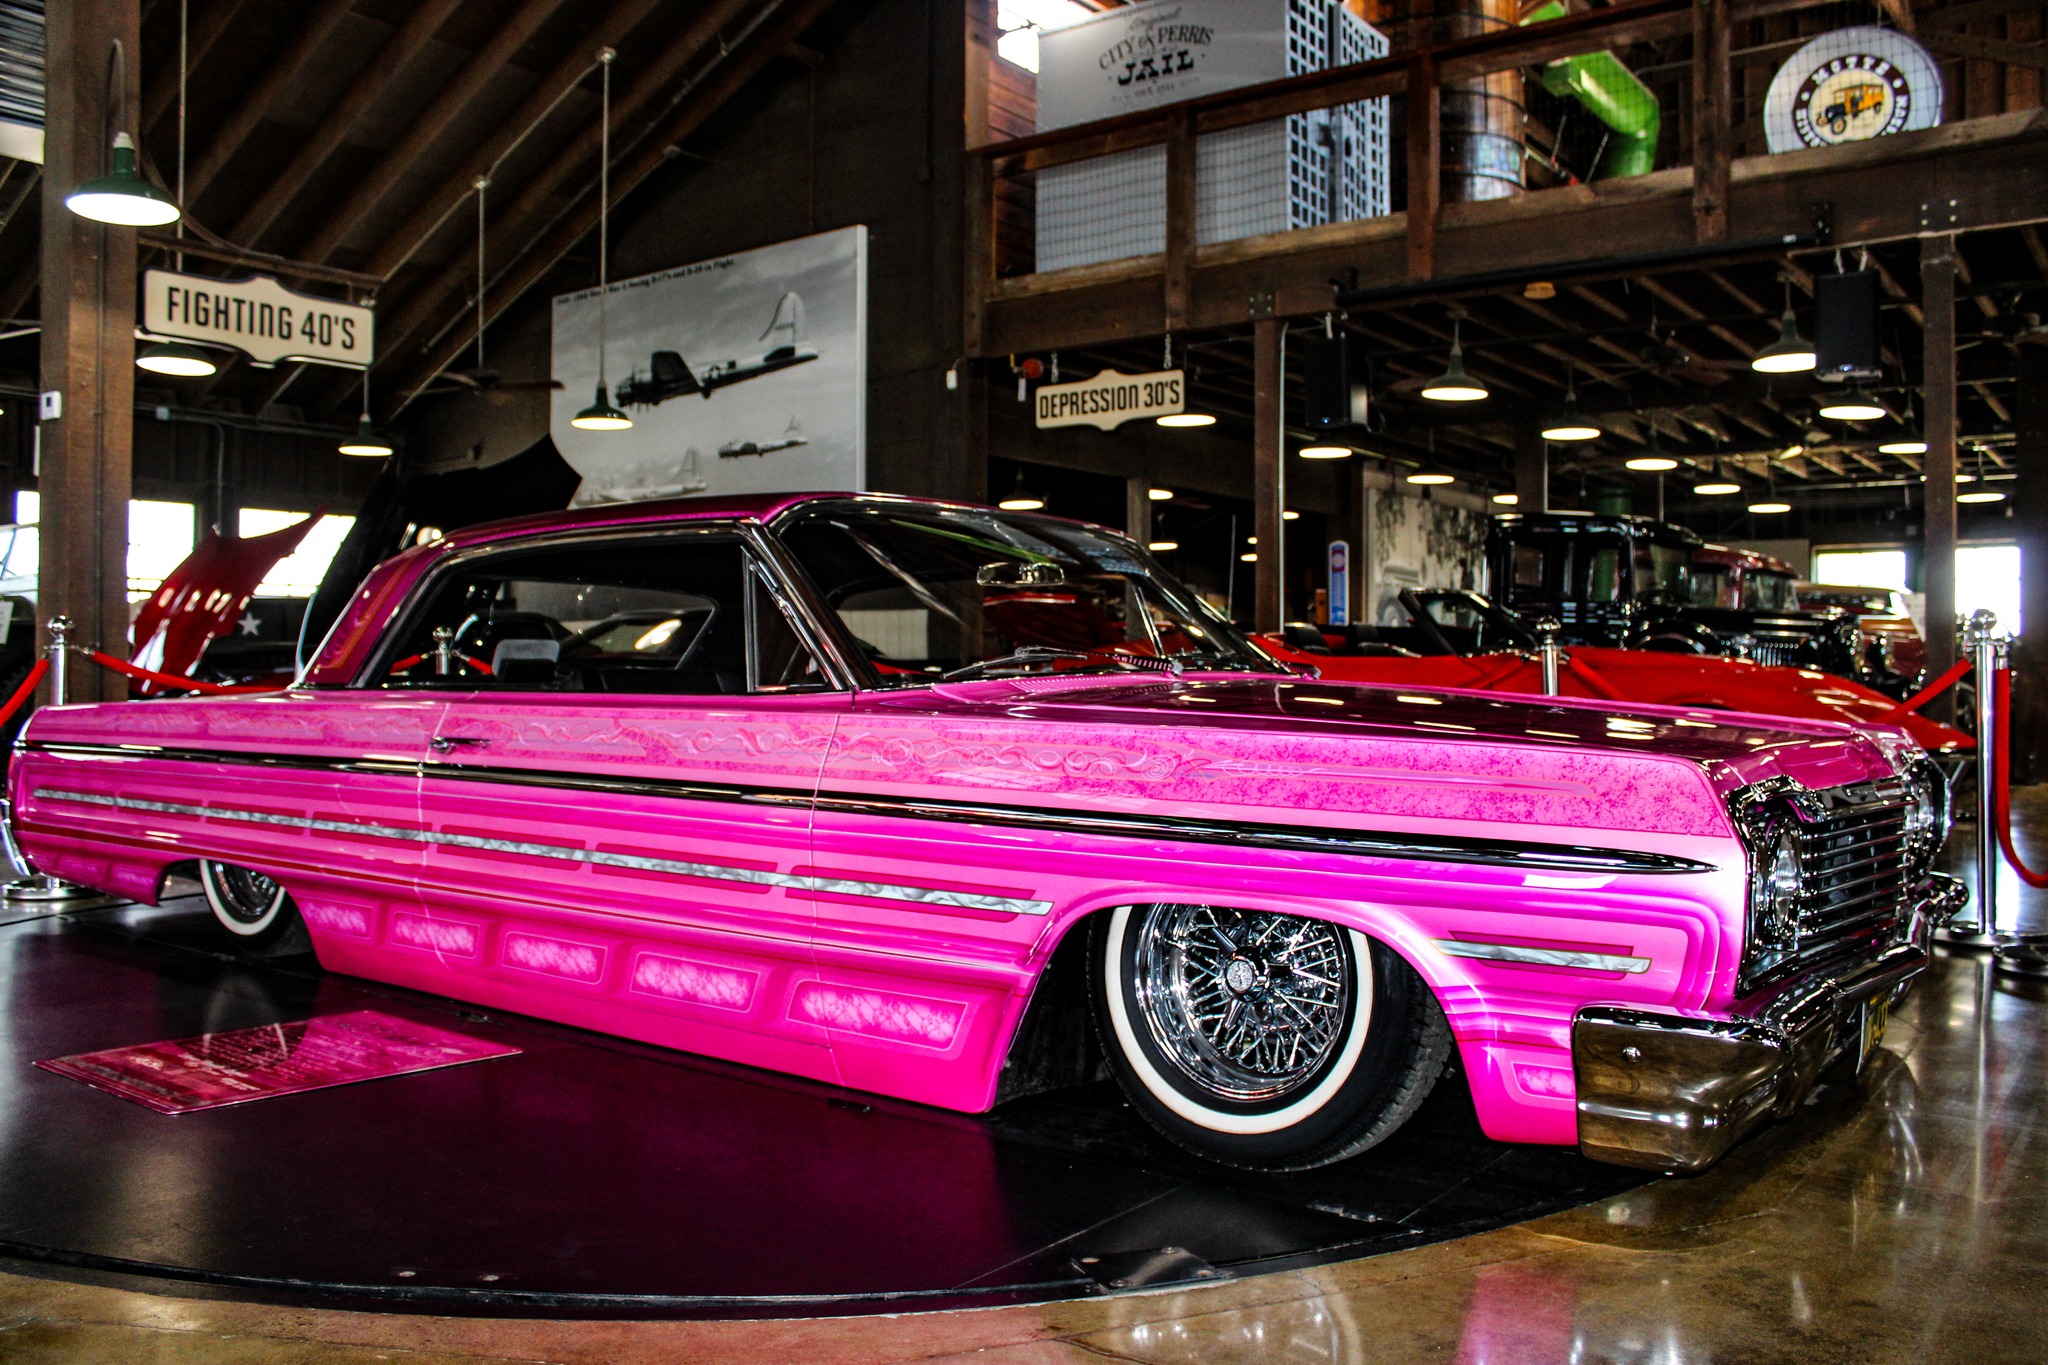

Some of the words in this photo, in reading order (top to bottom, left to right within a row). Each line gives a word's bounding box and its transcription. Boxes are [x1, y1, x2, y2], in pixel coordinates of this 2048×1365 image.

[1098, 35, 1135, 70] CITY
[1157, 24, 1214, 45] PERRIS
[1117, 49, 1194, 85] JAIL
[1811, 54, 1892, 85] MOTTE
[167, 286, 292, 340] FIGHTING
[301, 311, 355, 350] 40'S
[1040, 384, 1139, 419] DEPRESSION
[1144, 379, 1180, 408] 30'S
